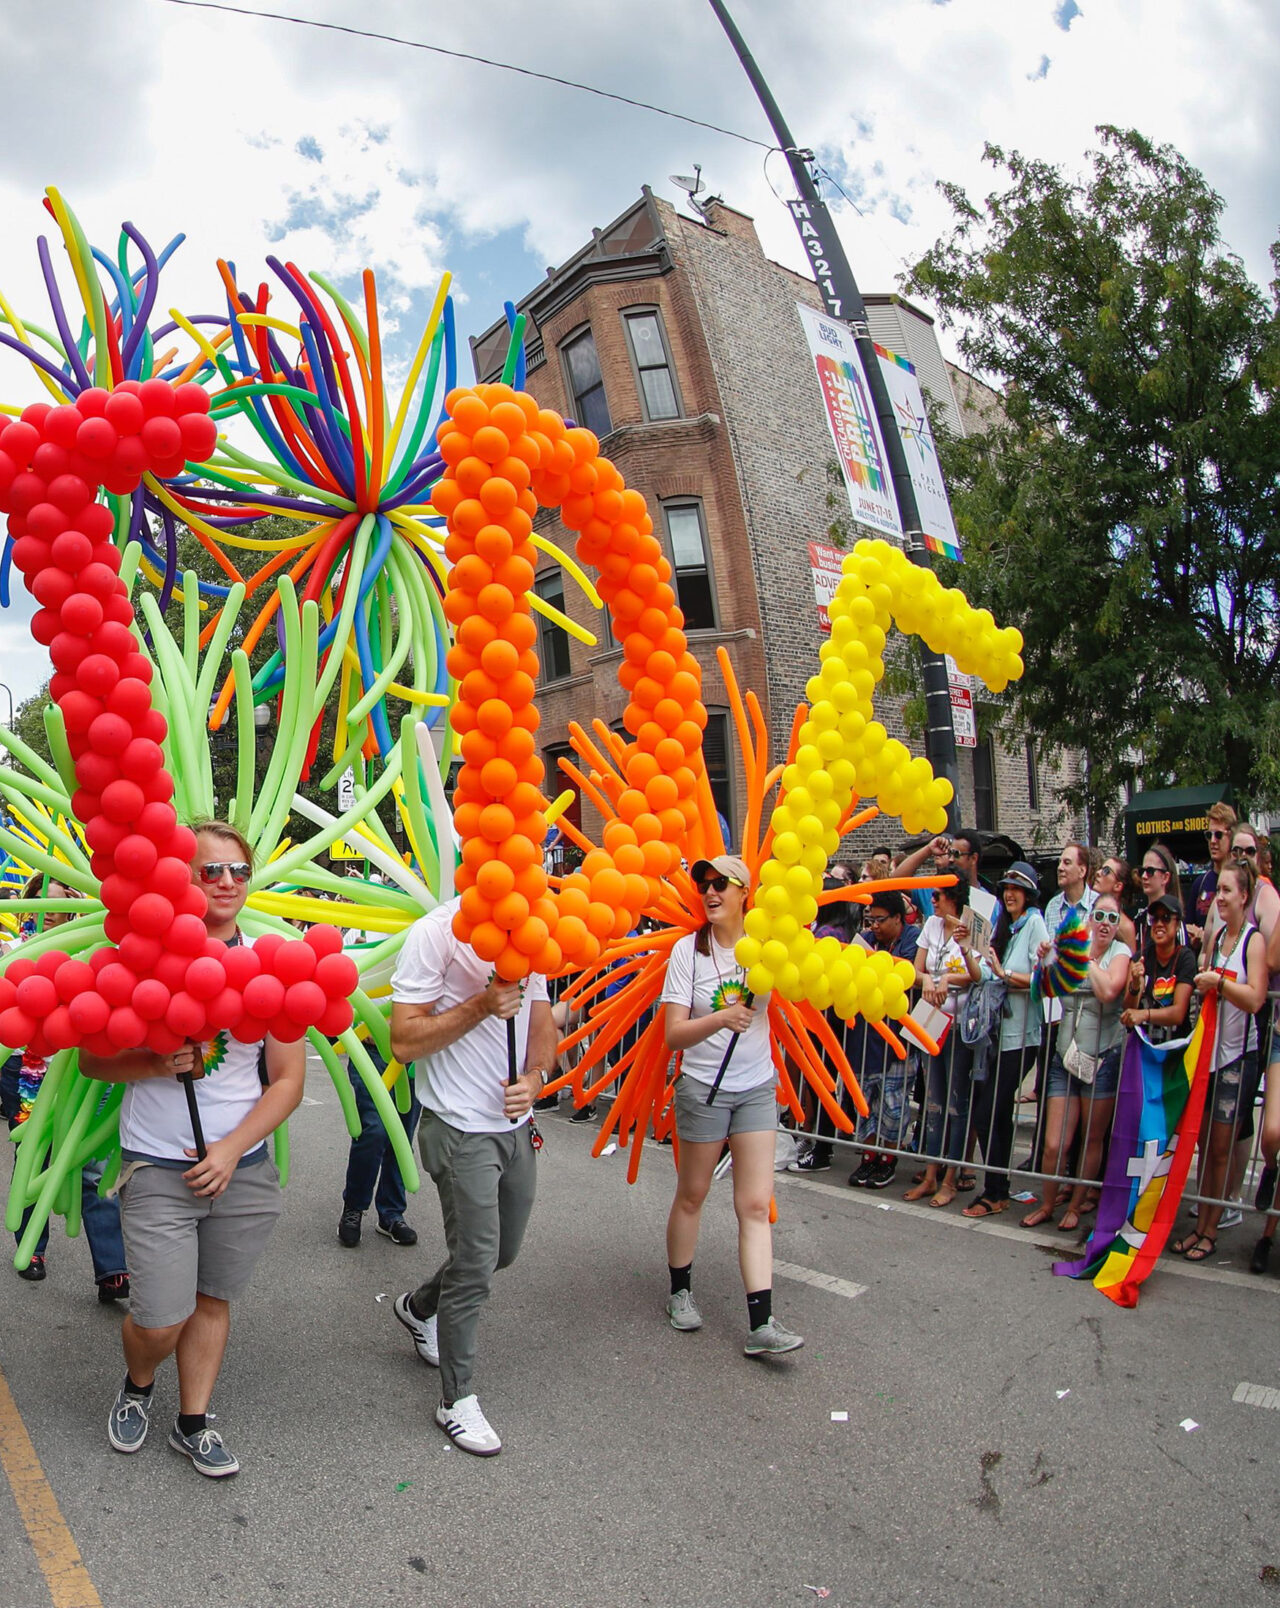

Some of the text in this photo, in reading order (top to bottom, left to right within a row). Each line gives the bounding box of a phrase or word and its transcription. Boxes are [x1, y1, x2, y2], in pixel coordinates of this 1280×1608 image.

[790, 202, 841, 317] HA3217
[819, 322, 837, 338] BUD
[818, 330, 843, 349] LIGHT
[831, 371, 870, 466] PRIDE
[833, 410, 852, 460] CHICAGO
[860, 418, 881, 472] FEST
[913, 479, 946, 500] CHICAGO
[858, 497, 876, 512] JUNE
[815, 545, 834, 560] Want
[820, 561, 842, 570] busine
[816, 574, 839, 588] ADVE
[1136, 820, 1171, 835] CLOTHES
[1172, 821, 1183, 830] AND
